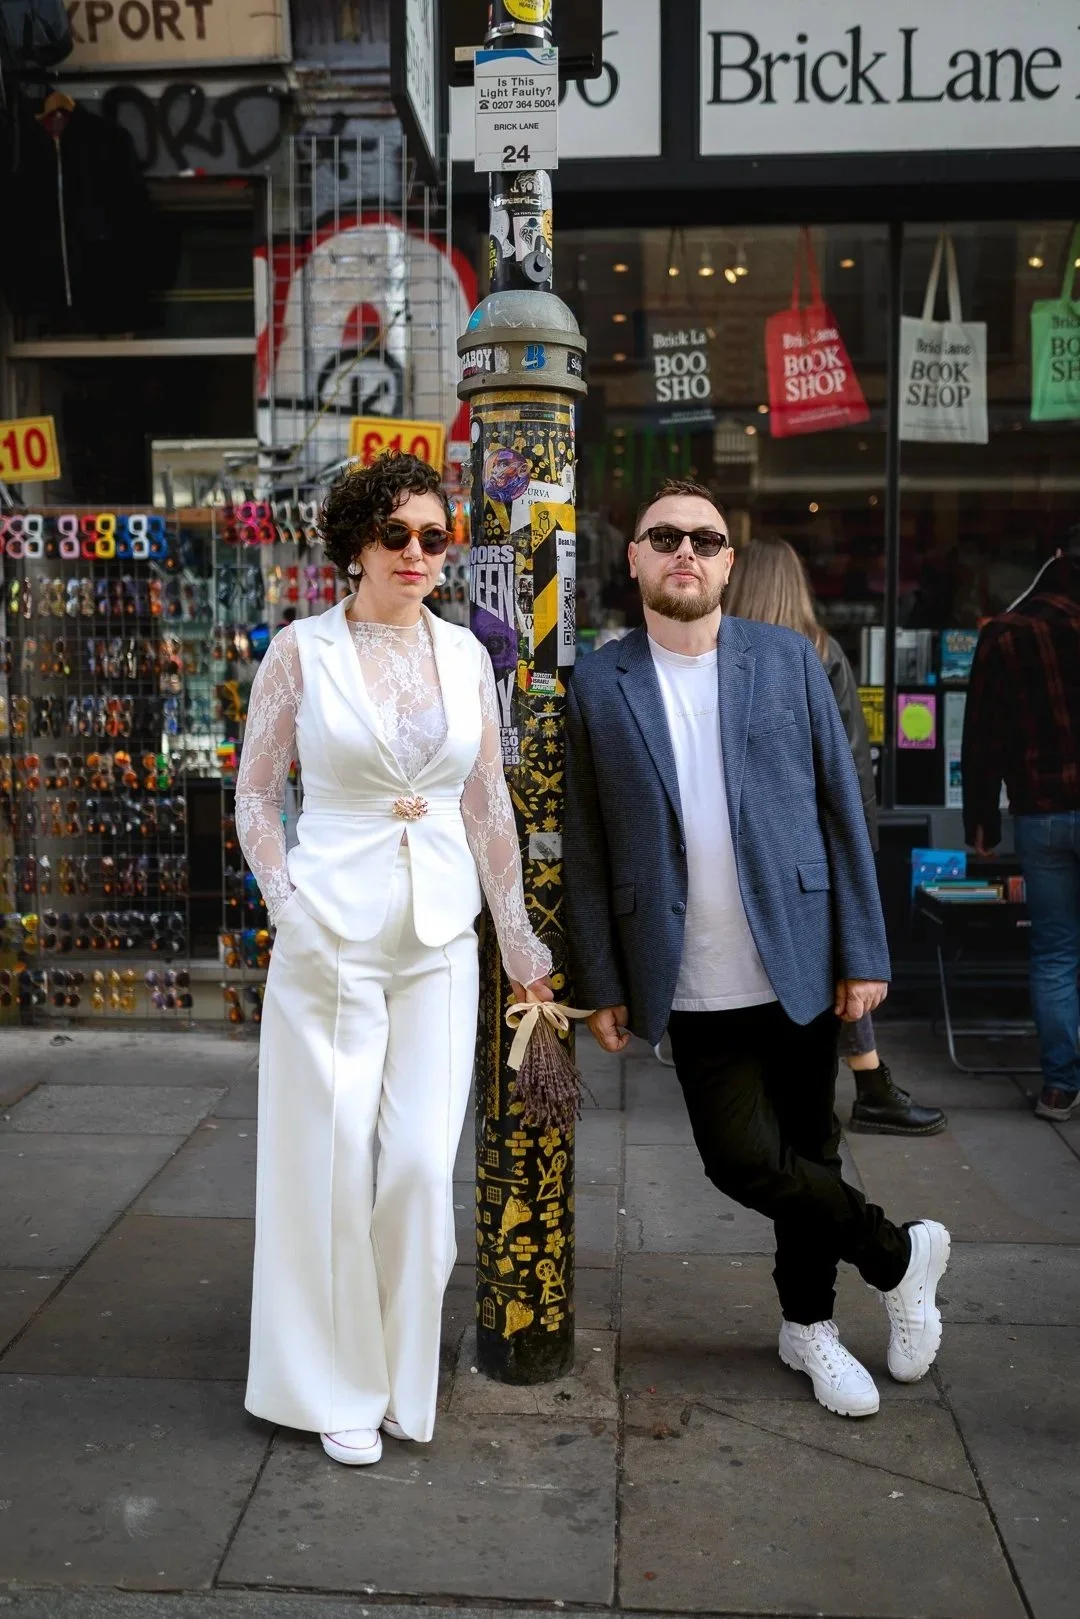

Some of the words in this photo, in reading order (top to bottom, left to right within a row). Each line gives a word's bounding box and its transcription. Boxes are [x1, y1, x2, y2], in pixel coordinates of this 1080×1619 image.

[707, 25, 891, 105] Brick
[897, 27, 1062, 102] Lane
[480, 88, 508, 99] Light
[512, 86, 552, 97] Faulty?
[497, 78, 507, 87] Is
[511, 77, 534, 86] This
[492, 101, 513, 110] 0207
[516, 100, 532, 109] 364
[534, 99, 556, 108] 5004
[494, 123, 517, 131] BRICK
[519, 122, 539, 130] LANE
[502, 145, 530, 163] 24
[783, 344, 845, 379] BOOK
[910, 359, 971, 384] BOOK
[784, 368, 847, 403] SHOP
[905, 382, 972, 409] SHOP
[0, 426, 49, 472] 10
[524, 487, 549, 499] URVA
